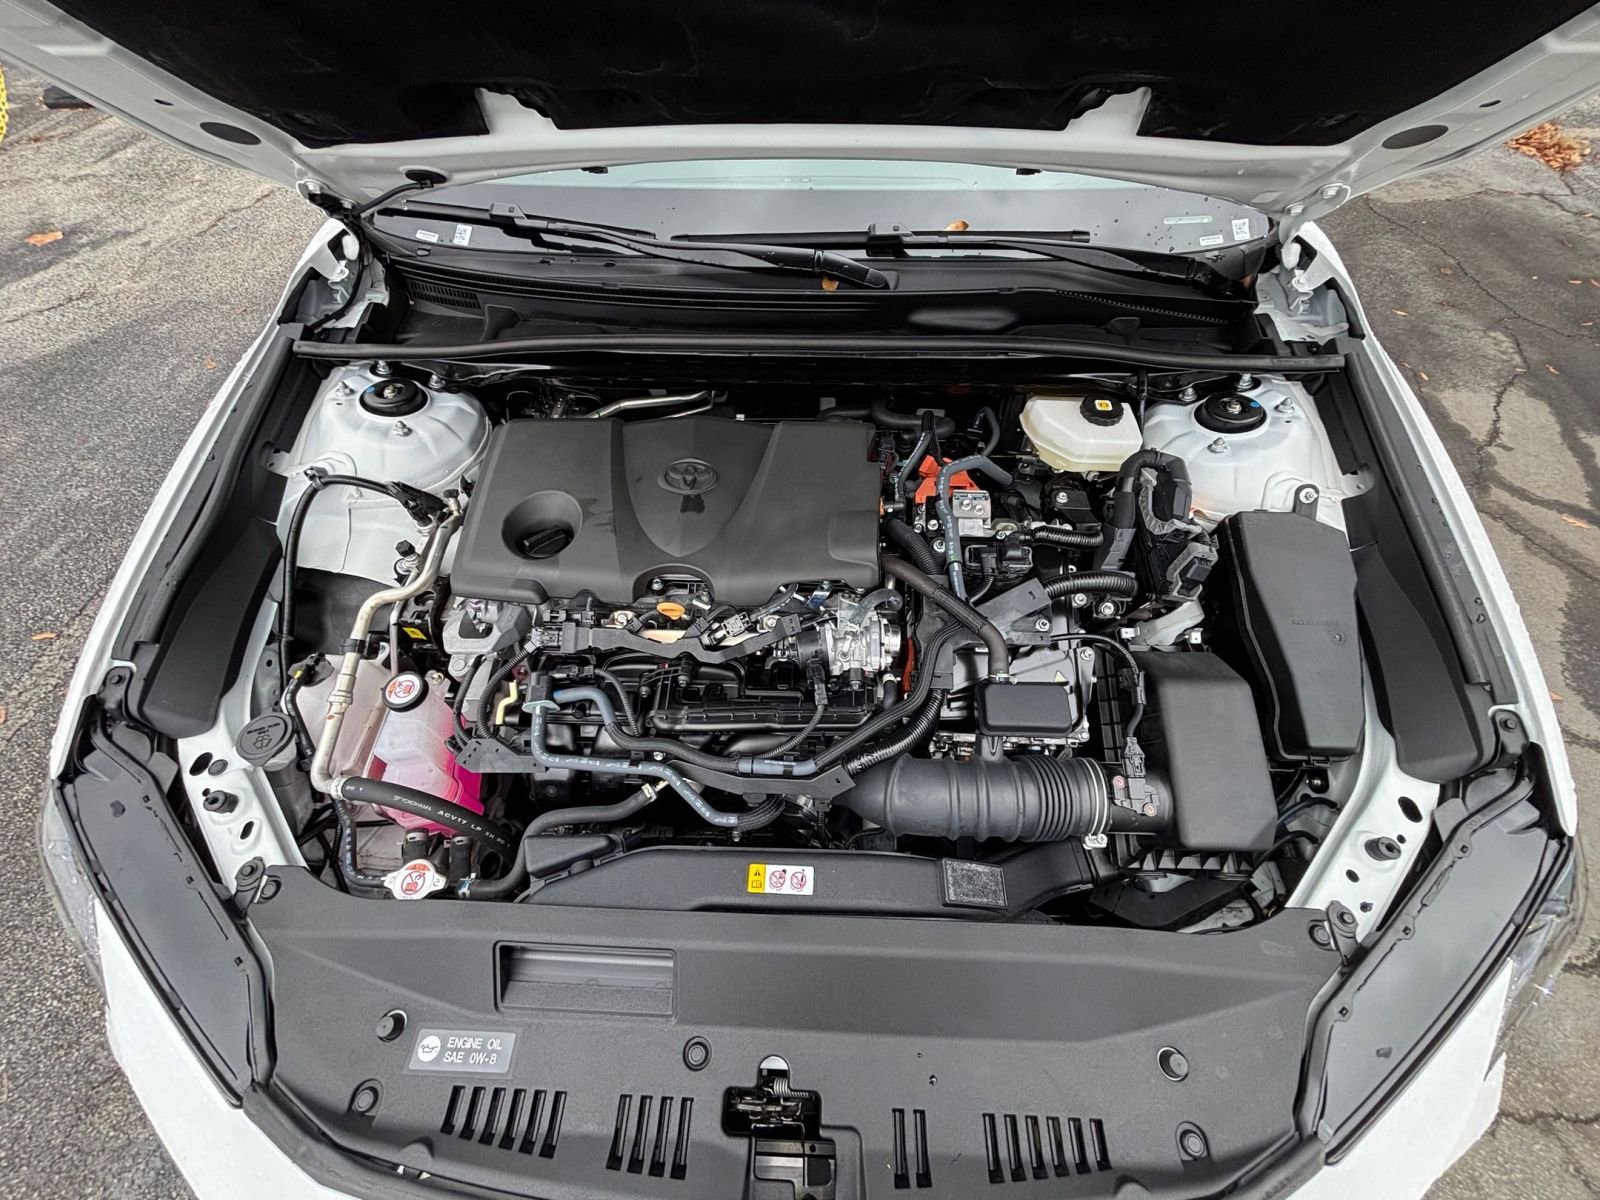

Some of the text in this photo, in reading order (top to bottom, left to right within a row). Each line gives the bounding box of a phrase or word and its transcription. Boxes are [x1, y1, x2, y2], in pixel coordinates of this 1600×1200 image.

[437, 810, 468, 825] ACV17
[447, 1036, 503, 1050] ENGINE OIL
[443, 1051, 498, 1065] SAE 0W-8
